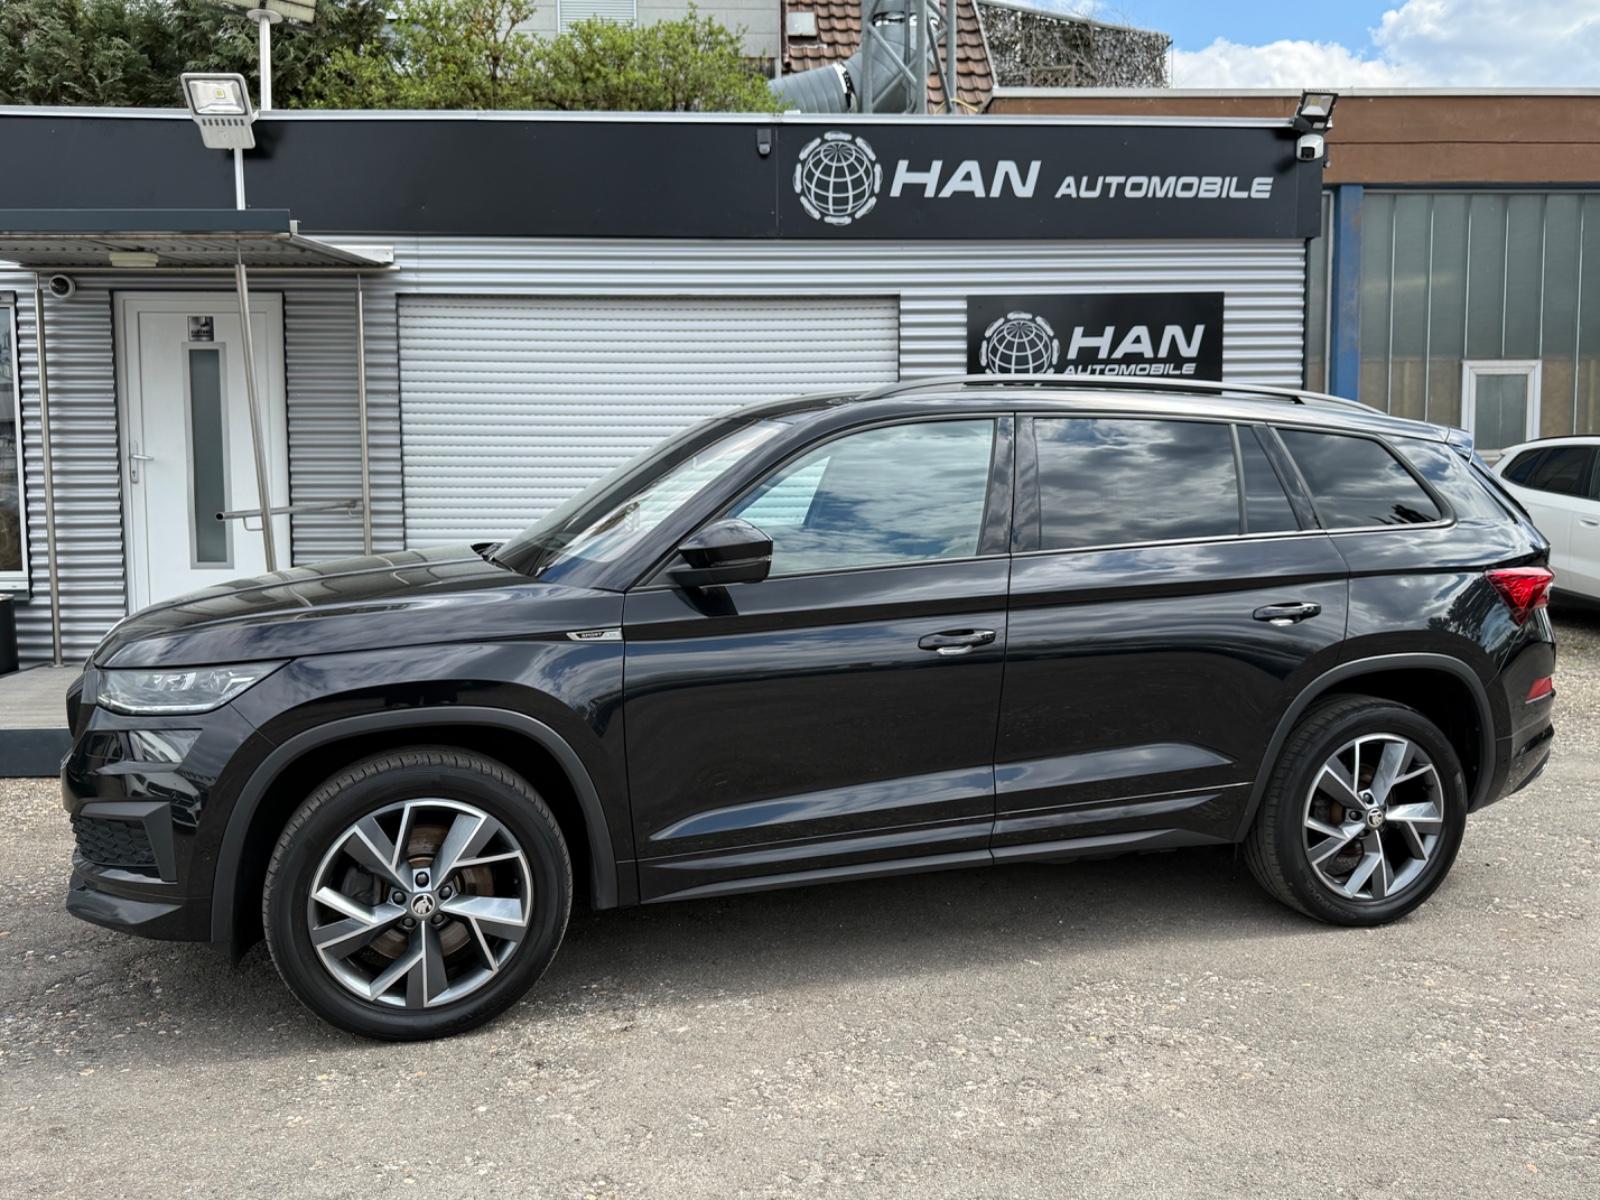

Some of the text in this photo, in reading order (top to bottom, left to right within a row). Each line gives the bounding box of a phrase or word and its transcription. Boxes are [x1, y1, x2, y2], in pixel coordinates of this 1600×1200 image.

[889, 159, 1274, 199] HAN AUTOMOBILE
[1066, 324, 1205, 360] HAN
[1064, 362, 1196, 376] AUTOMOBILE
